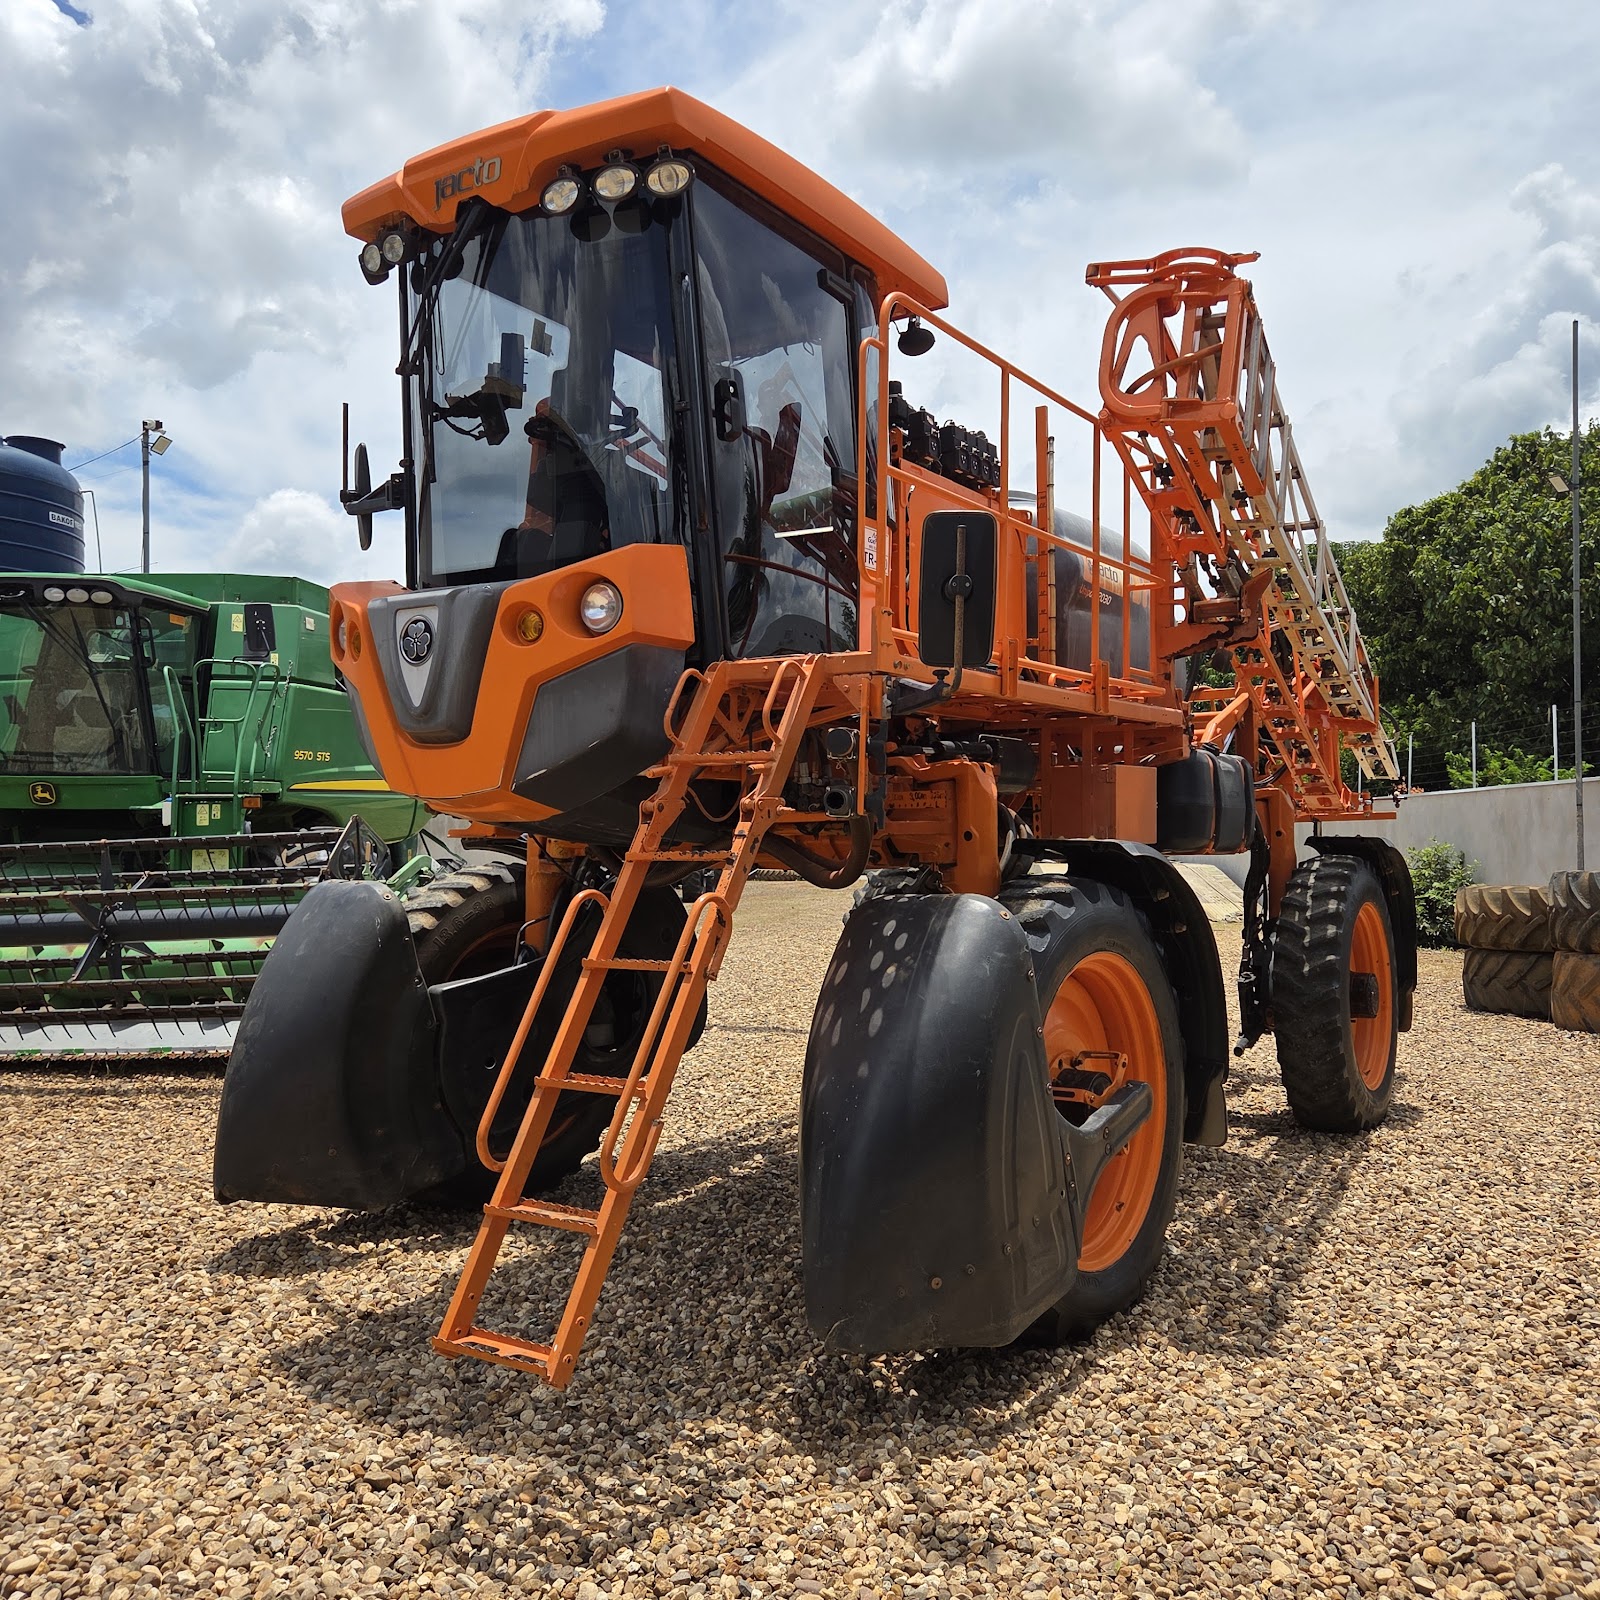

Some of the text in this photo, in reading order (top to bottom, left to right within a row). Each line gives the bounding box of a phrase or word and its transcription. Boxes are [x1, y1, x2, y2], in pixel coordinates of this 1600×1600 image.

[434, 156, 502, 212] jacto
[293, 749, 331, 762] 9570 STS
